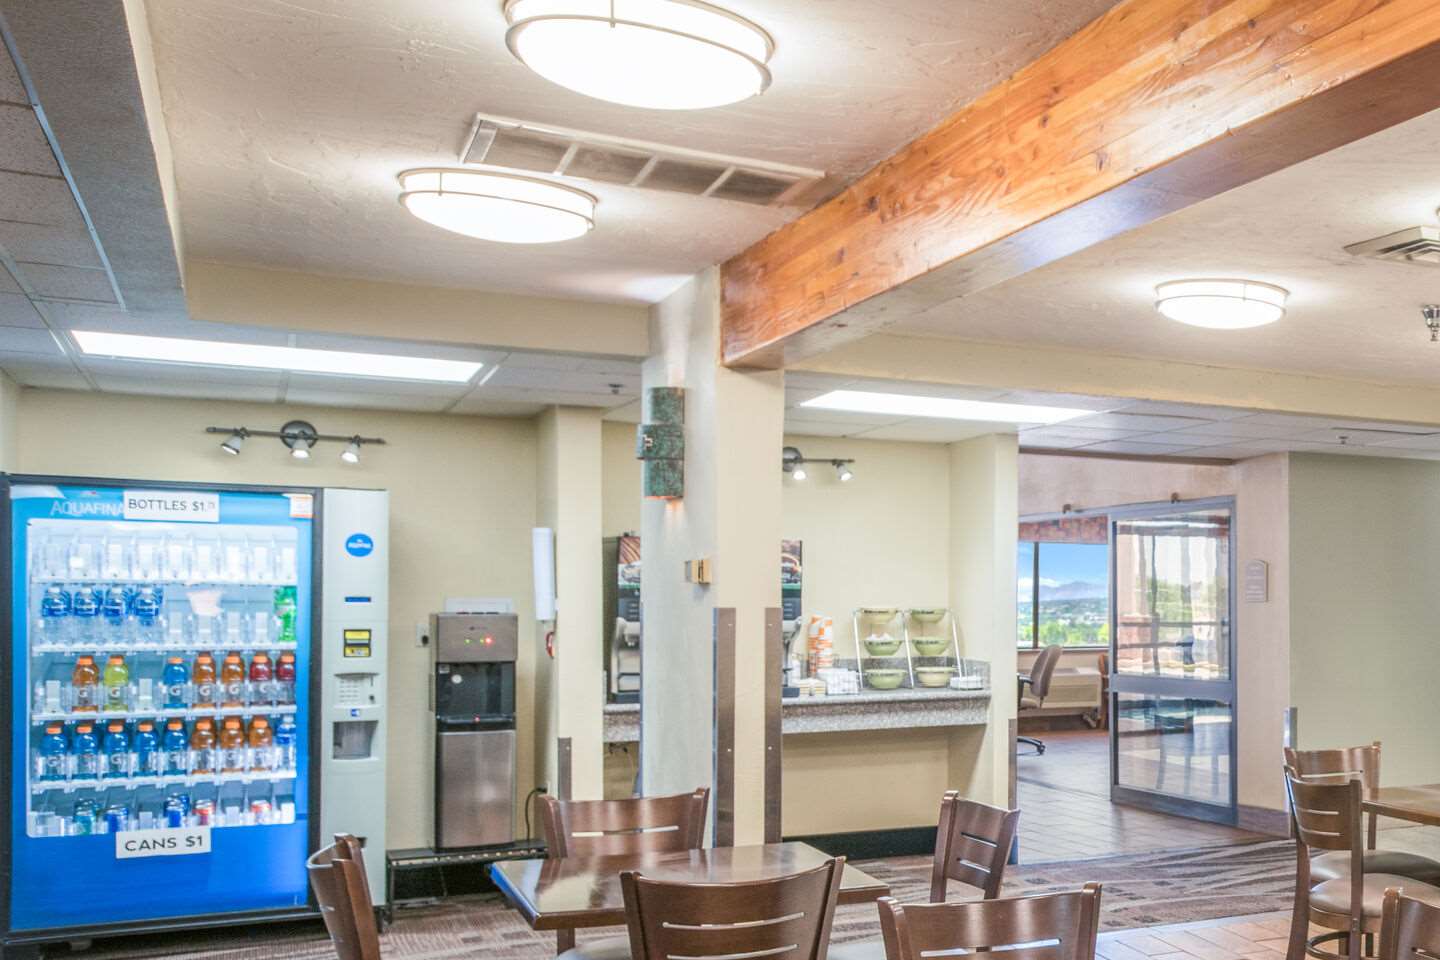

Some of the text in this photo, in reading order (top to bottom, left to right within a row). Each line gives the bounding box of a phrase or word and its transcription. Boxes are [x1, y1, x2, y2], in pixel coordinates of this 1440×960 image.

[128, 499, 187, 511] BOTTLES
[125, 835, 202, 851] CANS $1
